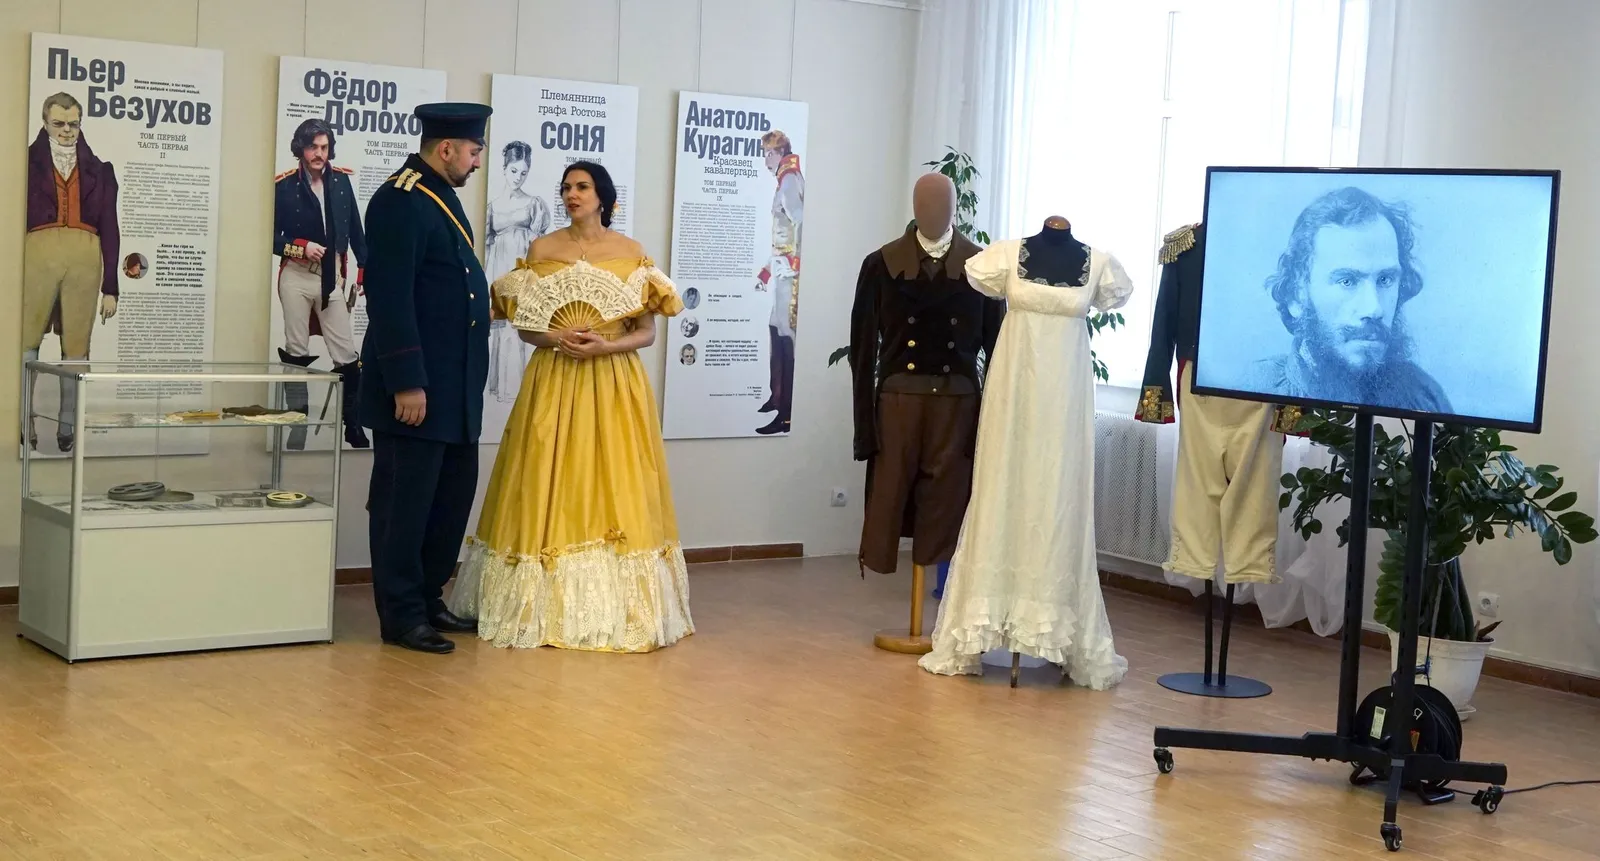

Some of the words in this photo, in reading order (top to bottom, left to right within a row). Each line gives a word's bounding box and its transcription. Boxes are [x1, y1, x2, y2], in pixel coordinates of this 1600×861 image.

[48, 47, 125, 92] Пьер
[304, 68, 397, 110] Фёдор
[541, 89, 606, 105] Племянница
[87, 85, 212, 129] Безухов
[324, 100, 422, 136] Долохо
[538, 105, 567, 116] графа
[571, 106, 606, 118] Ростова
[685, 100, 771, 132] Анатоль
[137, 141, 159, 150] ЧАСТЬ
[162, 143, 189, 152] ПЕРВАЯ
[156, 133, 187, 142] ПЕРВЫЙ
[381, 141, 408, 149] ПЕРВЫЙ
[540, 120, 605, 152] СОНЯ
[684, 127, 765, 160] Курагин
[704, 166, 758, 178] кавалергард
[713, 156, 752, 168] Красавец
